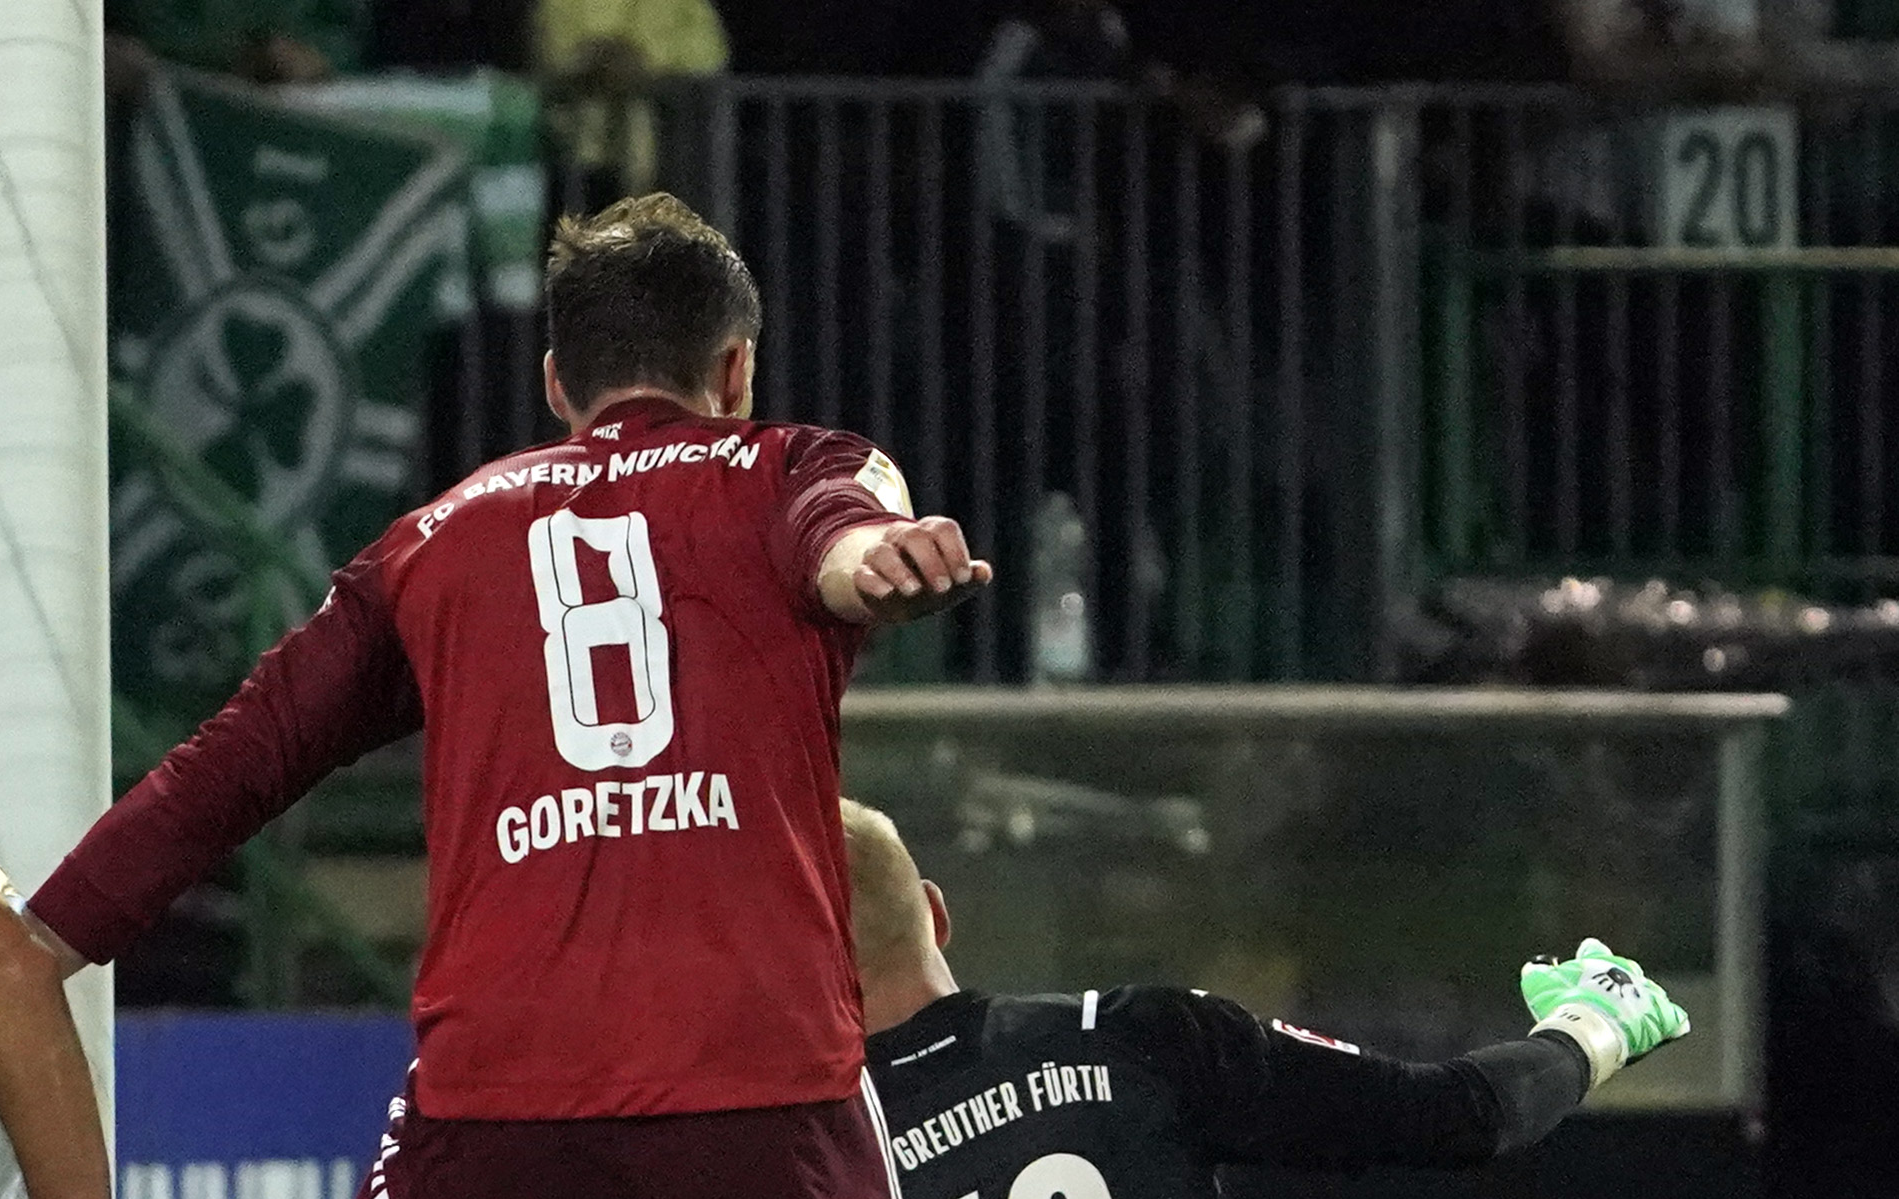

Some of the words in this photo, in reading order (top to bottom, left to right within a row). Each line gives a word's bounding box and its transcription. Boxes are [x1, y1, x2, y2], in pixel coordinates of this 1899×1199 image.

[1679, 130, 1782, 247] 20
[417, 502, 455, 539] FC
[463, 462, 603, 500] BAYERN
[528, 508, 674, 771] 8
[496, 771, 740, 864] GORETZKA
[891, 1081, 1023, 1171] GREUTHER
[1027, 1062, 1112, 1111] FÜRTH
